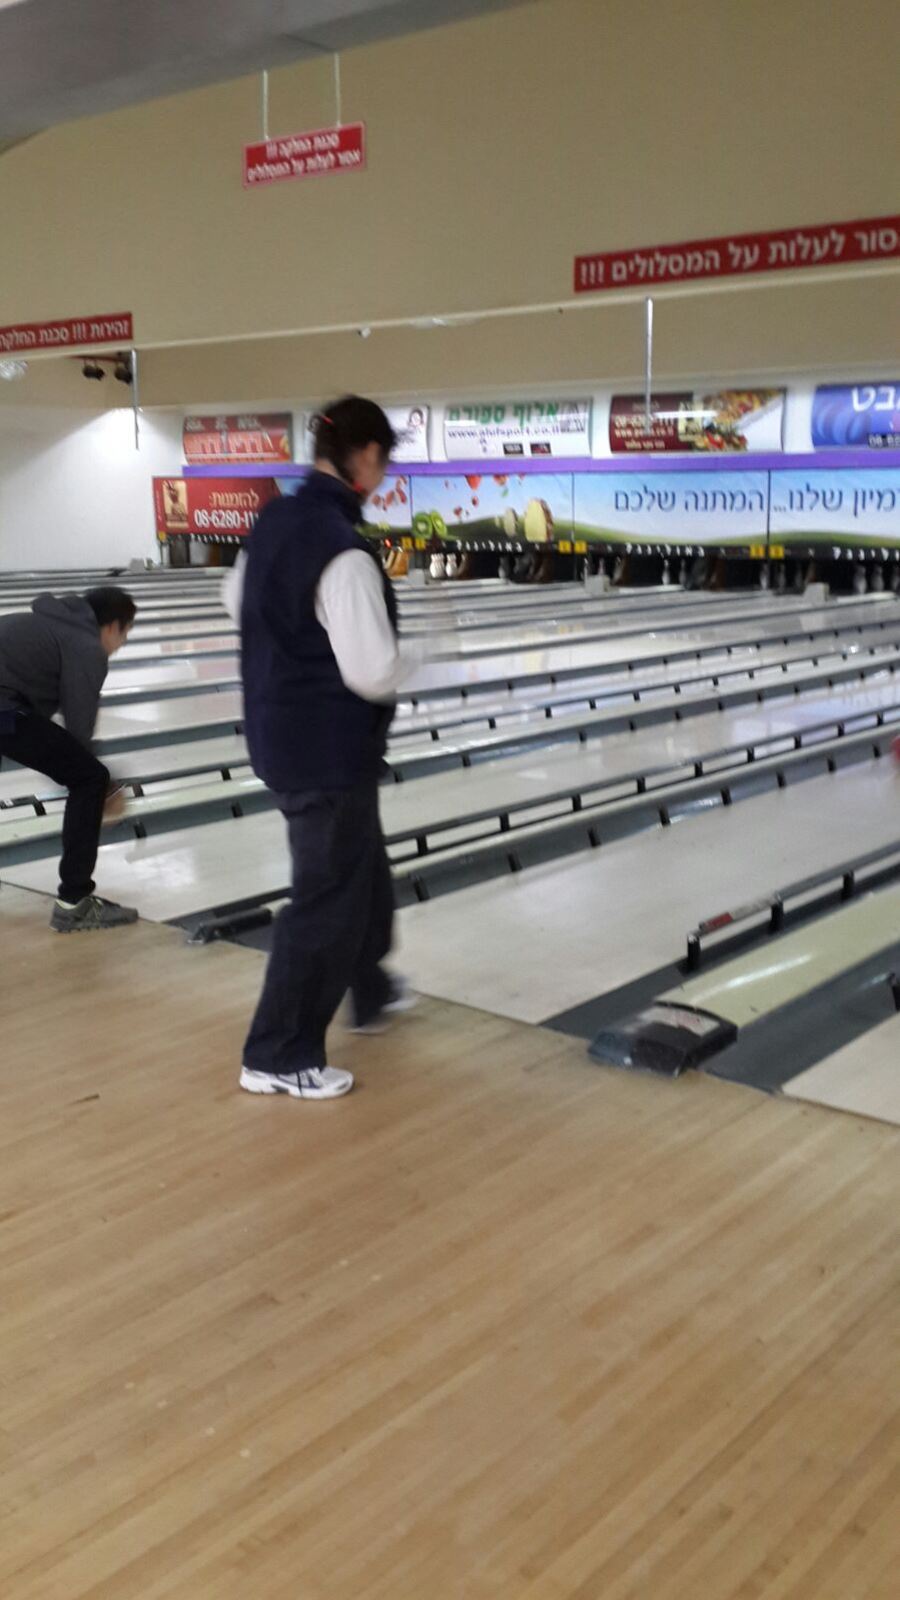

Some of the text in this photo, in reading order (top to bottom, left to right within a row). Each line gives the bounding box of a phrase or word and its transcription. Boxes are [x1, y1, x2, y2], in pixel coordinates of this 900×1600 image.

[728, 241, 760, 268] על
[768, 229, 845, 262] לעלות
[580, 260, 604, 284] !!!
[611, 250, 720, 282] המסלולים
[39, 327, 68, 343] סכנת
[90, 320, 129, 337] זהירות
[852, 386, 900, 412] בט
[614, 484, 676, 512] שלכם
[684, 488, 763, 512] המתנה
[853, 487, 900, 518] מיון
